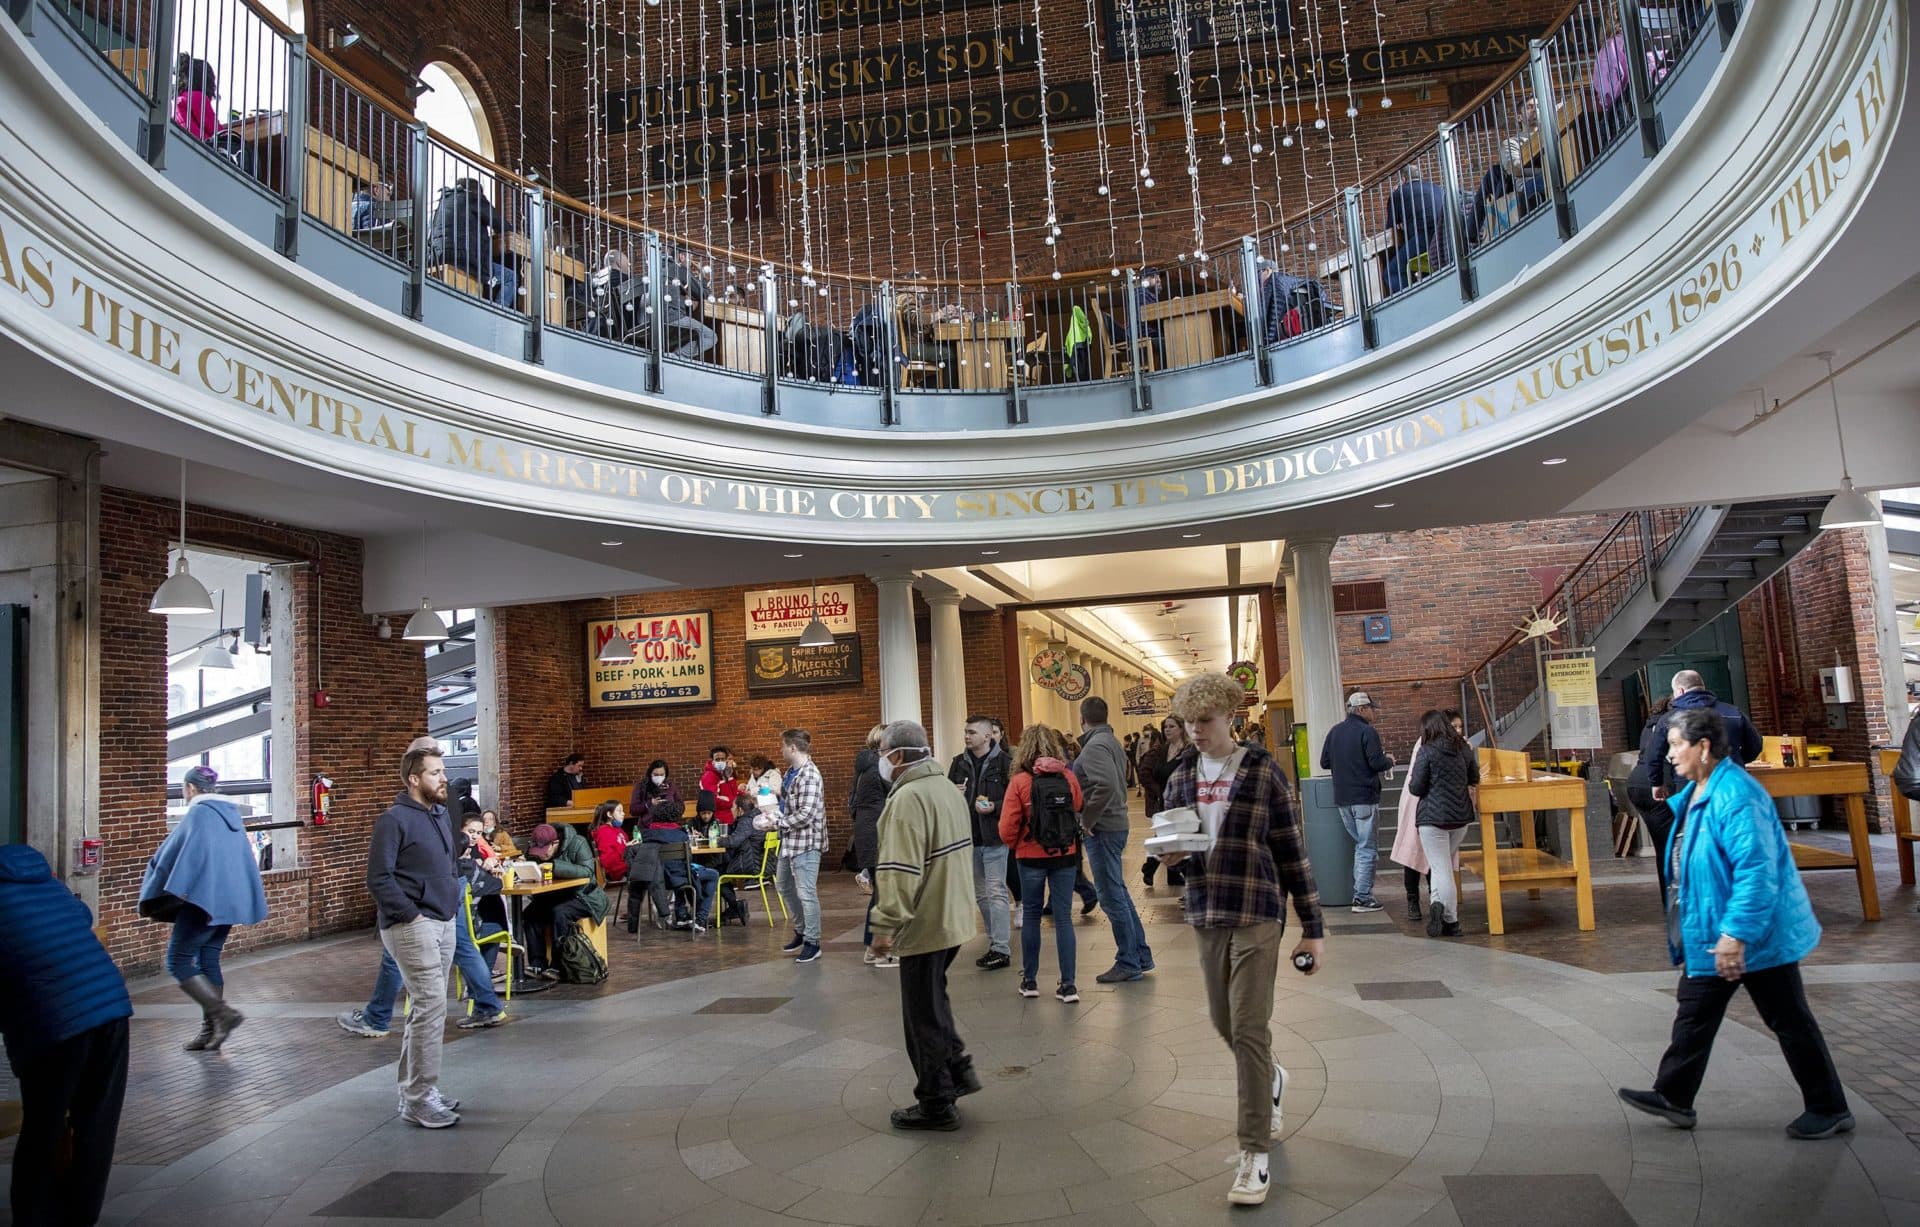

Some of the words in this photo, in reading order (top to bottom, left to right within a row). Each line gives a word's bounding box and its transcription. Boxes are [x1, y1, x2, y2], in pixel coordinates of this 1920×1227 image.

[1116, 7, 1168, 22] BUTTER
[1232, 58, 1347, 89] ADAMS
[1362, 34, 1528, 72] CHAPMAN
[622, 79, 739, 124] JULIUS
[759, 52, 898, 101] LANSKY
[907, 61, 923, 78] &
[937, 35, 1015, 73] SON
[1012, 90, 1078, 120] CO.
[72, 276, 180, 376] THE
[197, 347, 431, 460] CENTRAL
[447, 431, 648, 498] MARKET
[660, 474, 715, 505] OF
[728, 482, 817, 516] THE
[829, 490, 944, 520] CITY
[956, 485, 1095, 519] SINCE
[1111, 472, 1188, 508] ITS
[1204, 411, 1449, 497] DEDICATION
[1460, 386, 1498, 433] IN
[1511, 307, 1661, 412] AUGUST,
[1666, 243, 1743, 336] 1826
[1770, 116, 1852, 248] THIS
[768, 594, 809, 611] BRUNO
[823, 591, 842, 606] CO.
[756, 609, 788, 621] MEAT
[753, 622, 767, 631] 2-4
[773, 620, 804, 629] FANEUIL
[595, 616, 702, 657] McLEAN
[644, 640, 669, 663] CO.
[791, 647, 816, 656] EMPIRE
[818, 645, 838, 655] FRUIT
[840, 643, 853, 653] CO.
[596, 670, 624, 682] BEEF
[633, 667, 665, 680] PORK
[672, 664, 705, 677] LAMB
[791, 655, 850, 674] APPLECREST
[608, 692, 621, 700] 57
[630, 690, 644, 699] 59
[653, 688, 667, 697] 60
[678, 687, 692, 696] 62
[632, 681, 668, 690] STALLS
